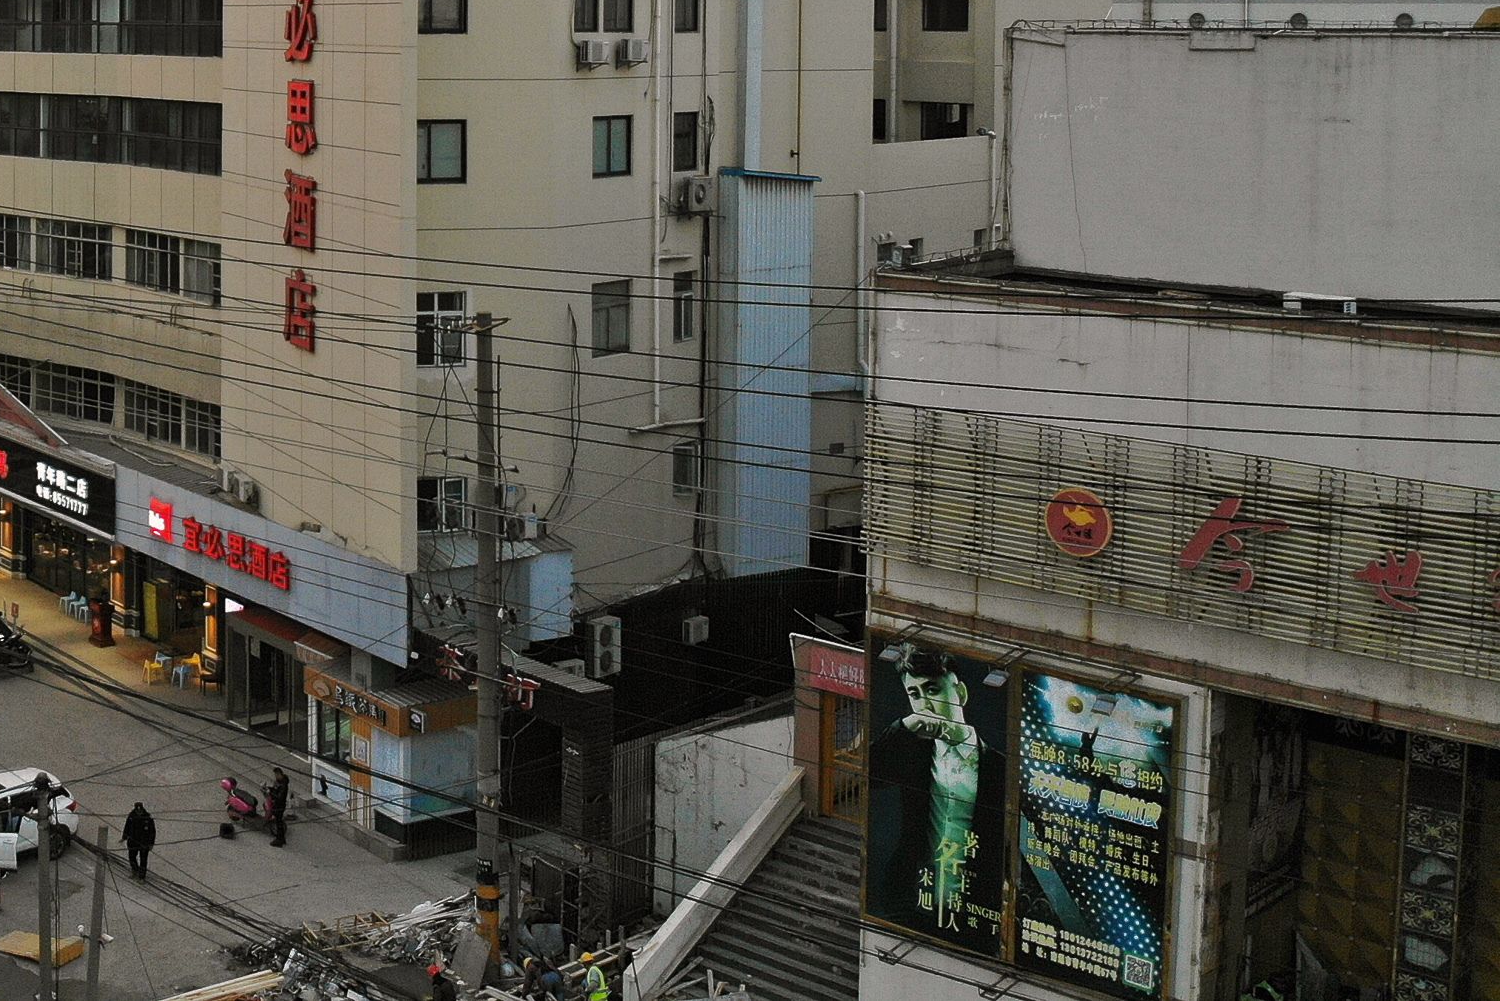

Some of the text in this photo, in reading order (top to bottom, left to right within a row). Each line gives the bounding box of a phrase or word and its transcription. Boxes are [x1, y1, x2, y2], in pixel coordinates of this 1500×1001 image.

[182, 516, 291, 592] 宜必思酒店
[966, 903, 1001, 922] SINGER
